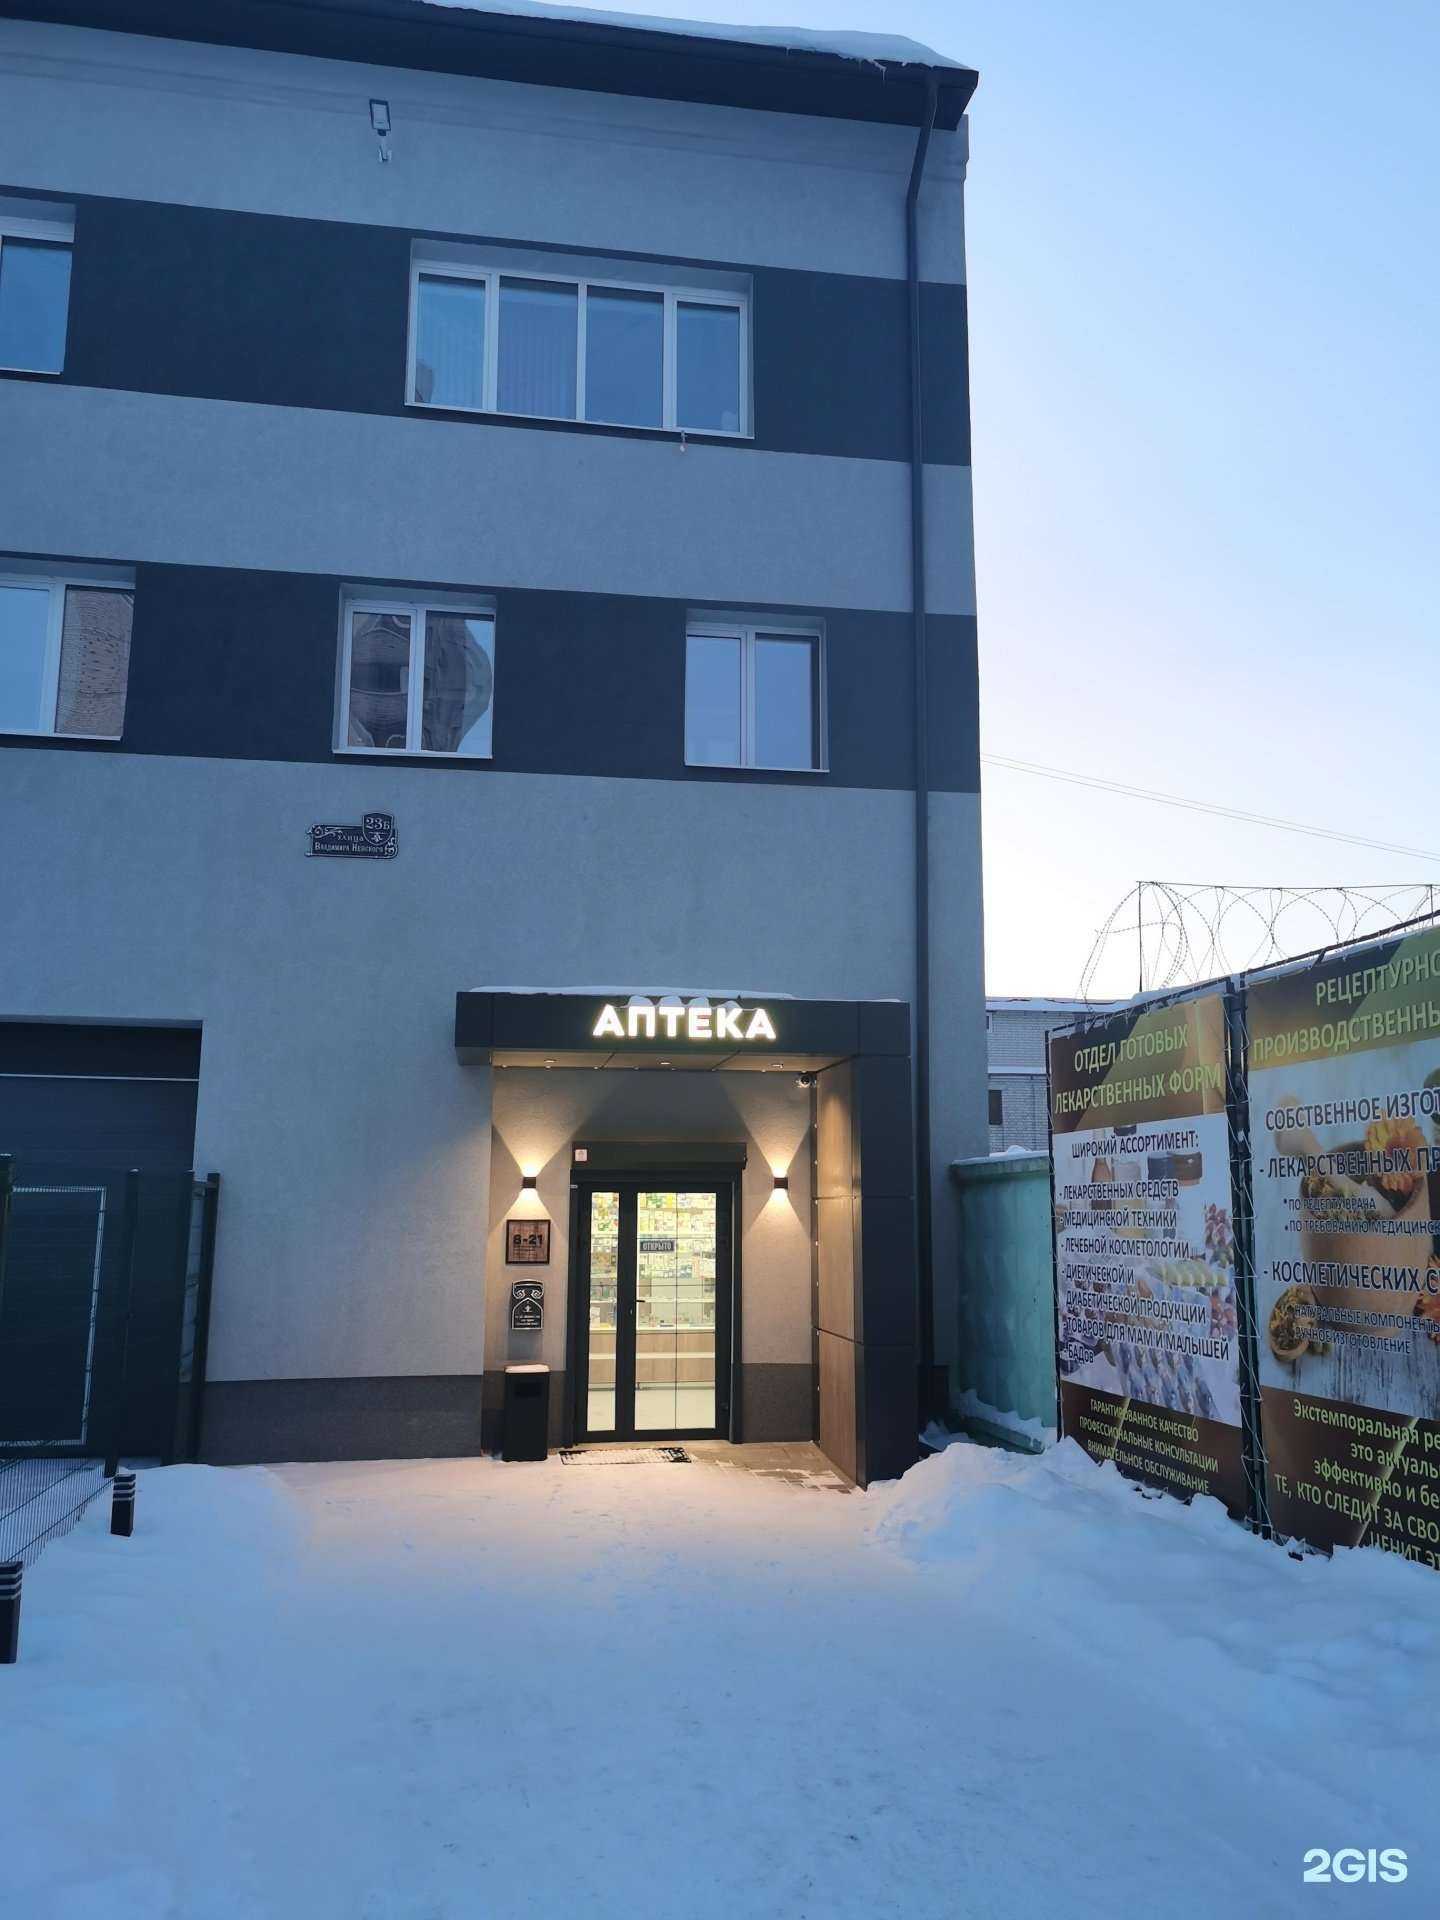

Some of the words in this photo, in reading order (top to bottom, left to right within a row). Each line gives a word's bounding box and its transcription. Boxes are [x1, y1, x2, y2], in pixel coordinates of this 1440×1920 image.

[592, 1003, 777, 1040] АПТЕКА
[1074, 1041, 1117, 1075] ОТДЕЛ
[1119, 1023, 1189, 1062] ГОТОВЫХ
[1055, 1073, 1166, 1114] ЛЕКАРСТВЕННЫХ
[1169, 1062, 1223, 1095] ФОРМ
[1265, 1097, 1380, 1131] СОБСТВЕННОЕ
[1072, 1135, 1117, 1158] ШИРОКИЙ
[1119, 1130, 1199, 1154] АССОРТИМЕНТ:
[1268, 1148, 1411, 1178] ЛЕКАРСТВЕННЫХ
[1063, 1181, 1134, 1200] ЛЕКАРСТВЕННЫХ
[1135, 1180, 1179, 1200] СРЕДСТВ
[1289, 1199, 1300, 1210] ПО
[1064, 1209, 1130, 1229] МЕДИЦИНСКОЙ
[1132, 1211, 1177, 1227] ТЕХНИКИ
[1289, 1220, 1302, 1232] ПО
[1303, 1220, 1369, 1233] ТРЕБОВАНИЮ
[1065, 1236, 1107, 1254] ЛЕЧЕБНОЙ
[1109, 1239, 1189, 1258] КОСМЕТОЛОГИИ
[1066, 1263, 1126, 1284] ДИЕТИЧЕСКОЙ
[1128, 1269, 1134, 1283] И
[1272, 1261, 1420, 1292] КОСМЕТИЧЕСКИХ
[1066, 1290, 1138, 1315] ДИАБЕТИЧЕСКОЙ
[1140, 1300, 1206, 1325] ПРОДУКЦИИ
[1066, 1317, 1104, 1338] ТОВАРОВ
[1106, 1322, 1125, 1340] ДЛЯ
[1128, 1326, 1153, 1346] МАМ
[1155, 1331, 1163, 1348] И
[1166, 1332, 1229, 1361] МАЛЫШЕЙ
[1333, 1332, 1411, 1354] ИЗГОТОВЛЕНИЕ
[1090, 1398, 1158, 1431] ГАРАНТИРОВАННОЕ
[1158, 1417, 1199, 1442] КАЧЕСТВО
[1293, 1399, 1419, 1445] Экстемпоральная
[1079, 1416, 1153, 1452] ПРОФЕССИОНАЛЬНЫЕ
[1155, 1440, 1219, 1473] КОНСУЛЬТАЦИИ
[1350, 1442, 1373, 1463] это
[1377, 1449, 1440, 1479] актуаль
[1087, 1439, 1143, 1470] ВНИМАТЕЛЬНОЕ
[1144, 1459, 1210, 1494] ОБСЛУЖИВАНИЕ
[1314, 1457, 1402, 1498] эффективно
[1406, 1485, 1416, 1503] и
[1274, 1473, 1292, 1499] ТЕ,
[1297, 1480, 1322, 1505] КТО
[1325, 1490, 1380, 1524] СЛЕДИТ
[1384, 1508, 1404, 1533] ЗА
[1407, 1515, 1440, 1543] СВО
